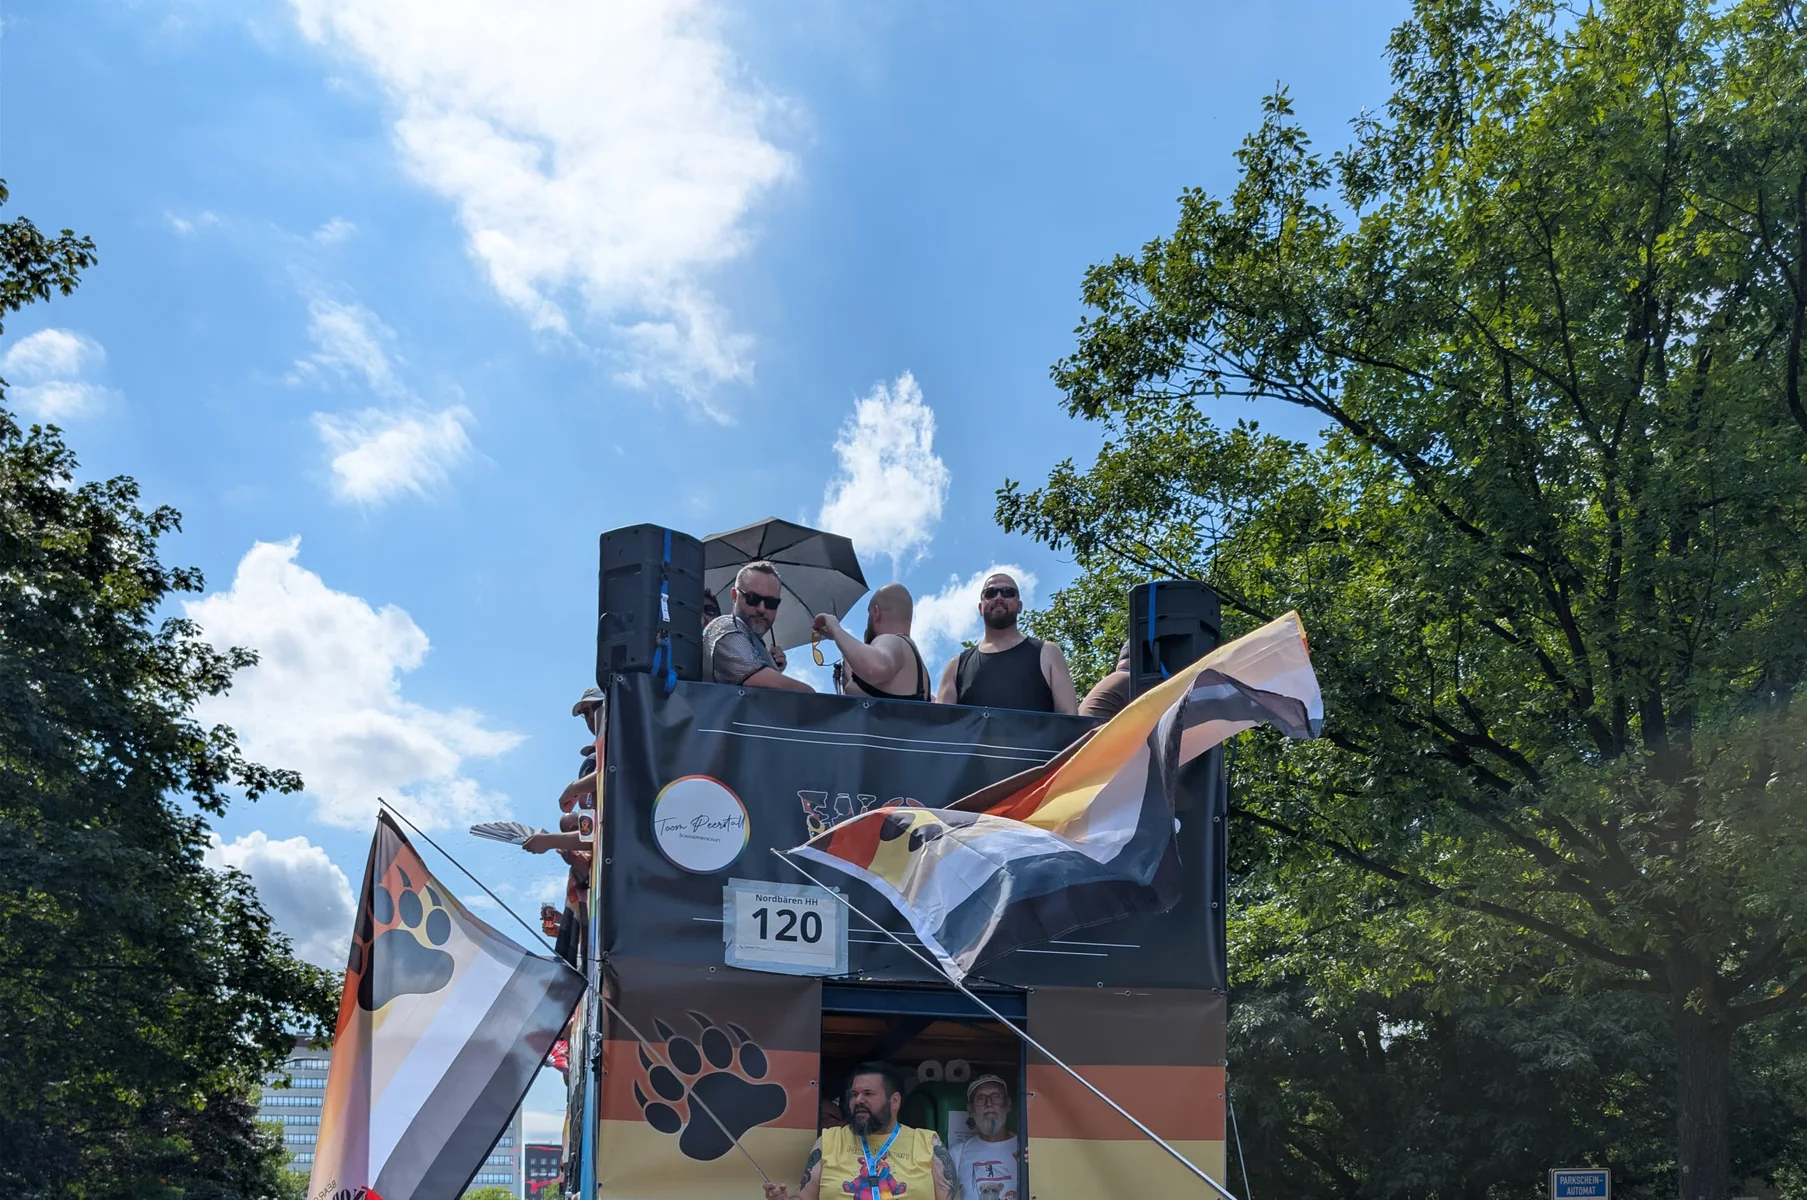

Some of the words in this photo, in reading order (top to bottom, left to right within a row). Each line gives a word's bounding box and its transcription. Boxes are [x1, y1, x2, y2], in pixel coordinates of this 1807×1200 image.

[654, 816, 688, 836] Toom
[690, 812, 746, 833] Peerstall
[755, 893, 803, 905] Nordbären
[805, 897, 818, 906] HH
[751, 906, 823, 944] 120
[1559, 1175, 1604, 1185] PARKSCHEIN-
[1566, 1186, 1597, 1196] AUTOMAT
